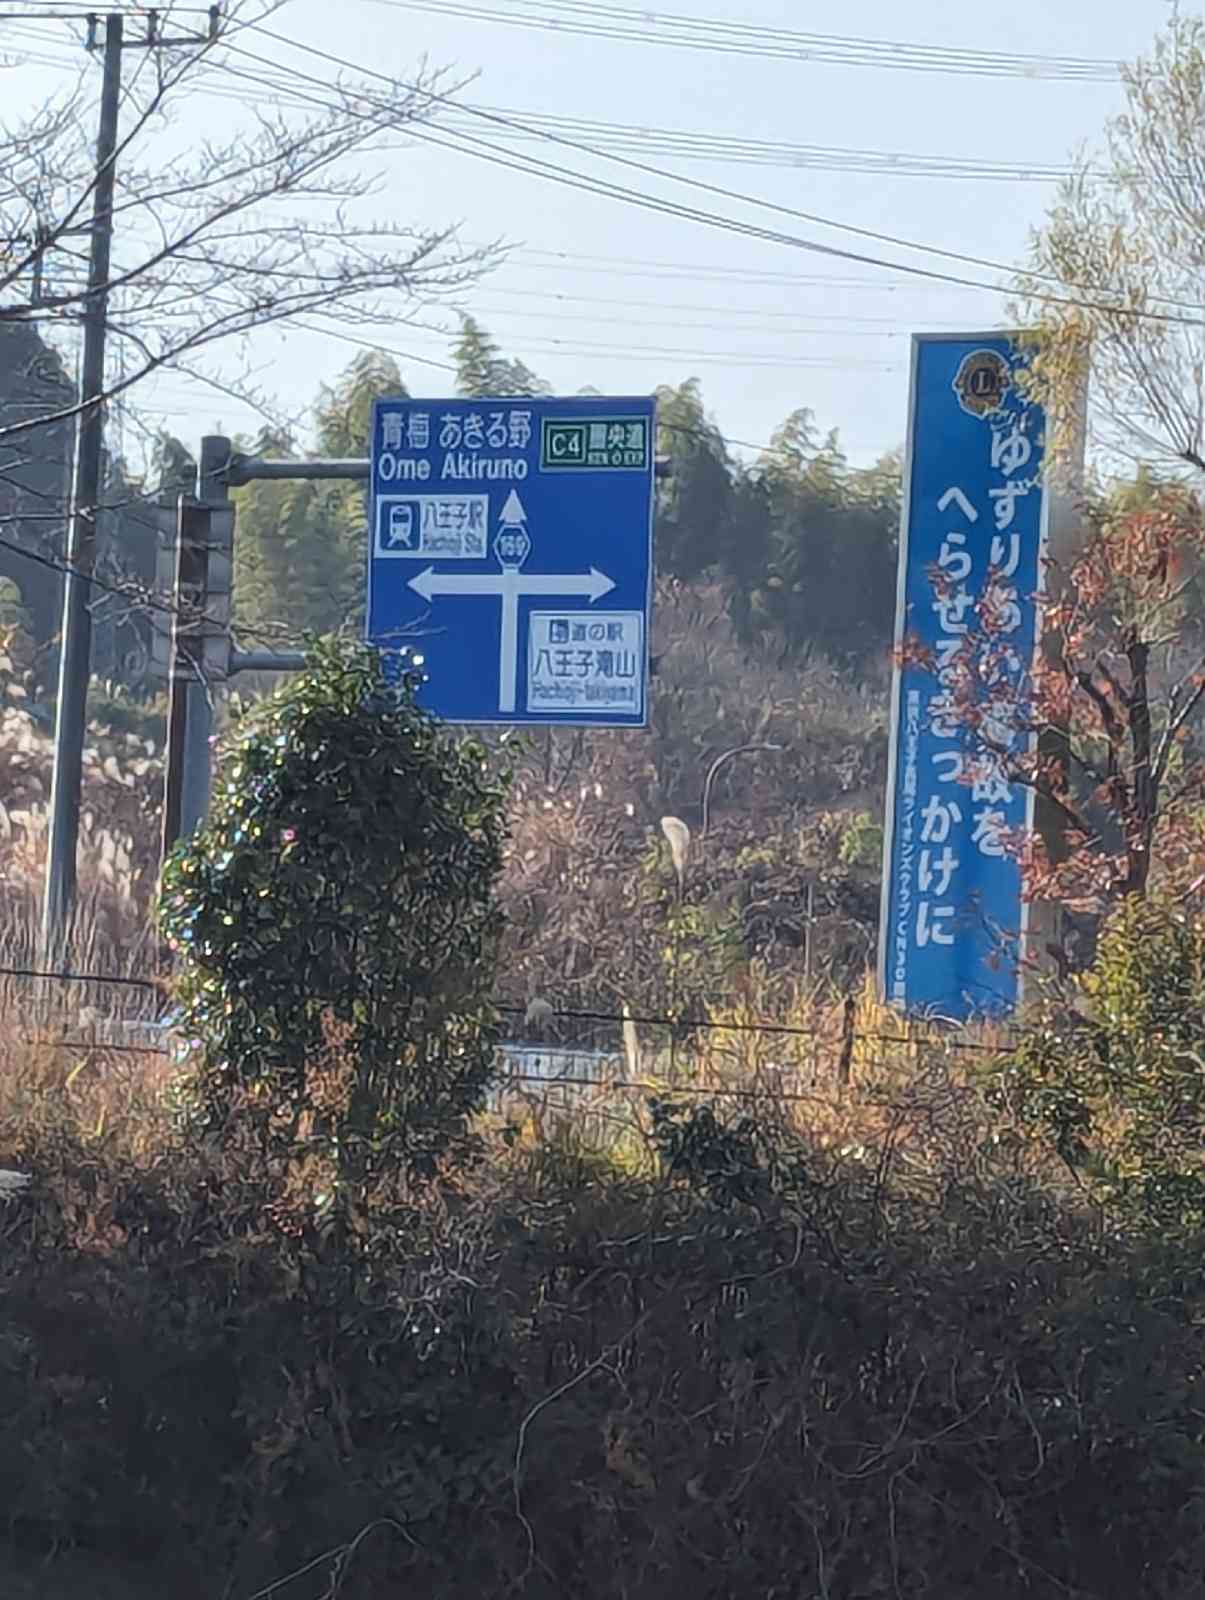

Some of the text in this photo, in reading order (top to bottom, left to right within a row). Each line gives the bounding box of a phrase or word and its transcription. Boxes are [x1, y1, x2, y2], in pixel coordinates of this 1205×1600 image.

[439, 410, 532, 449] あきる野
[552, 433, 580, 457] C4
[378, 452, 528, 480] Ome Akiruno
